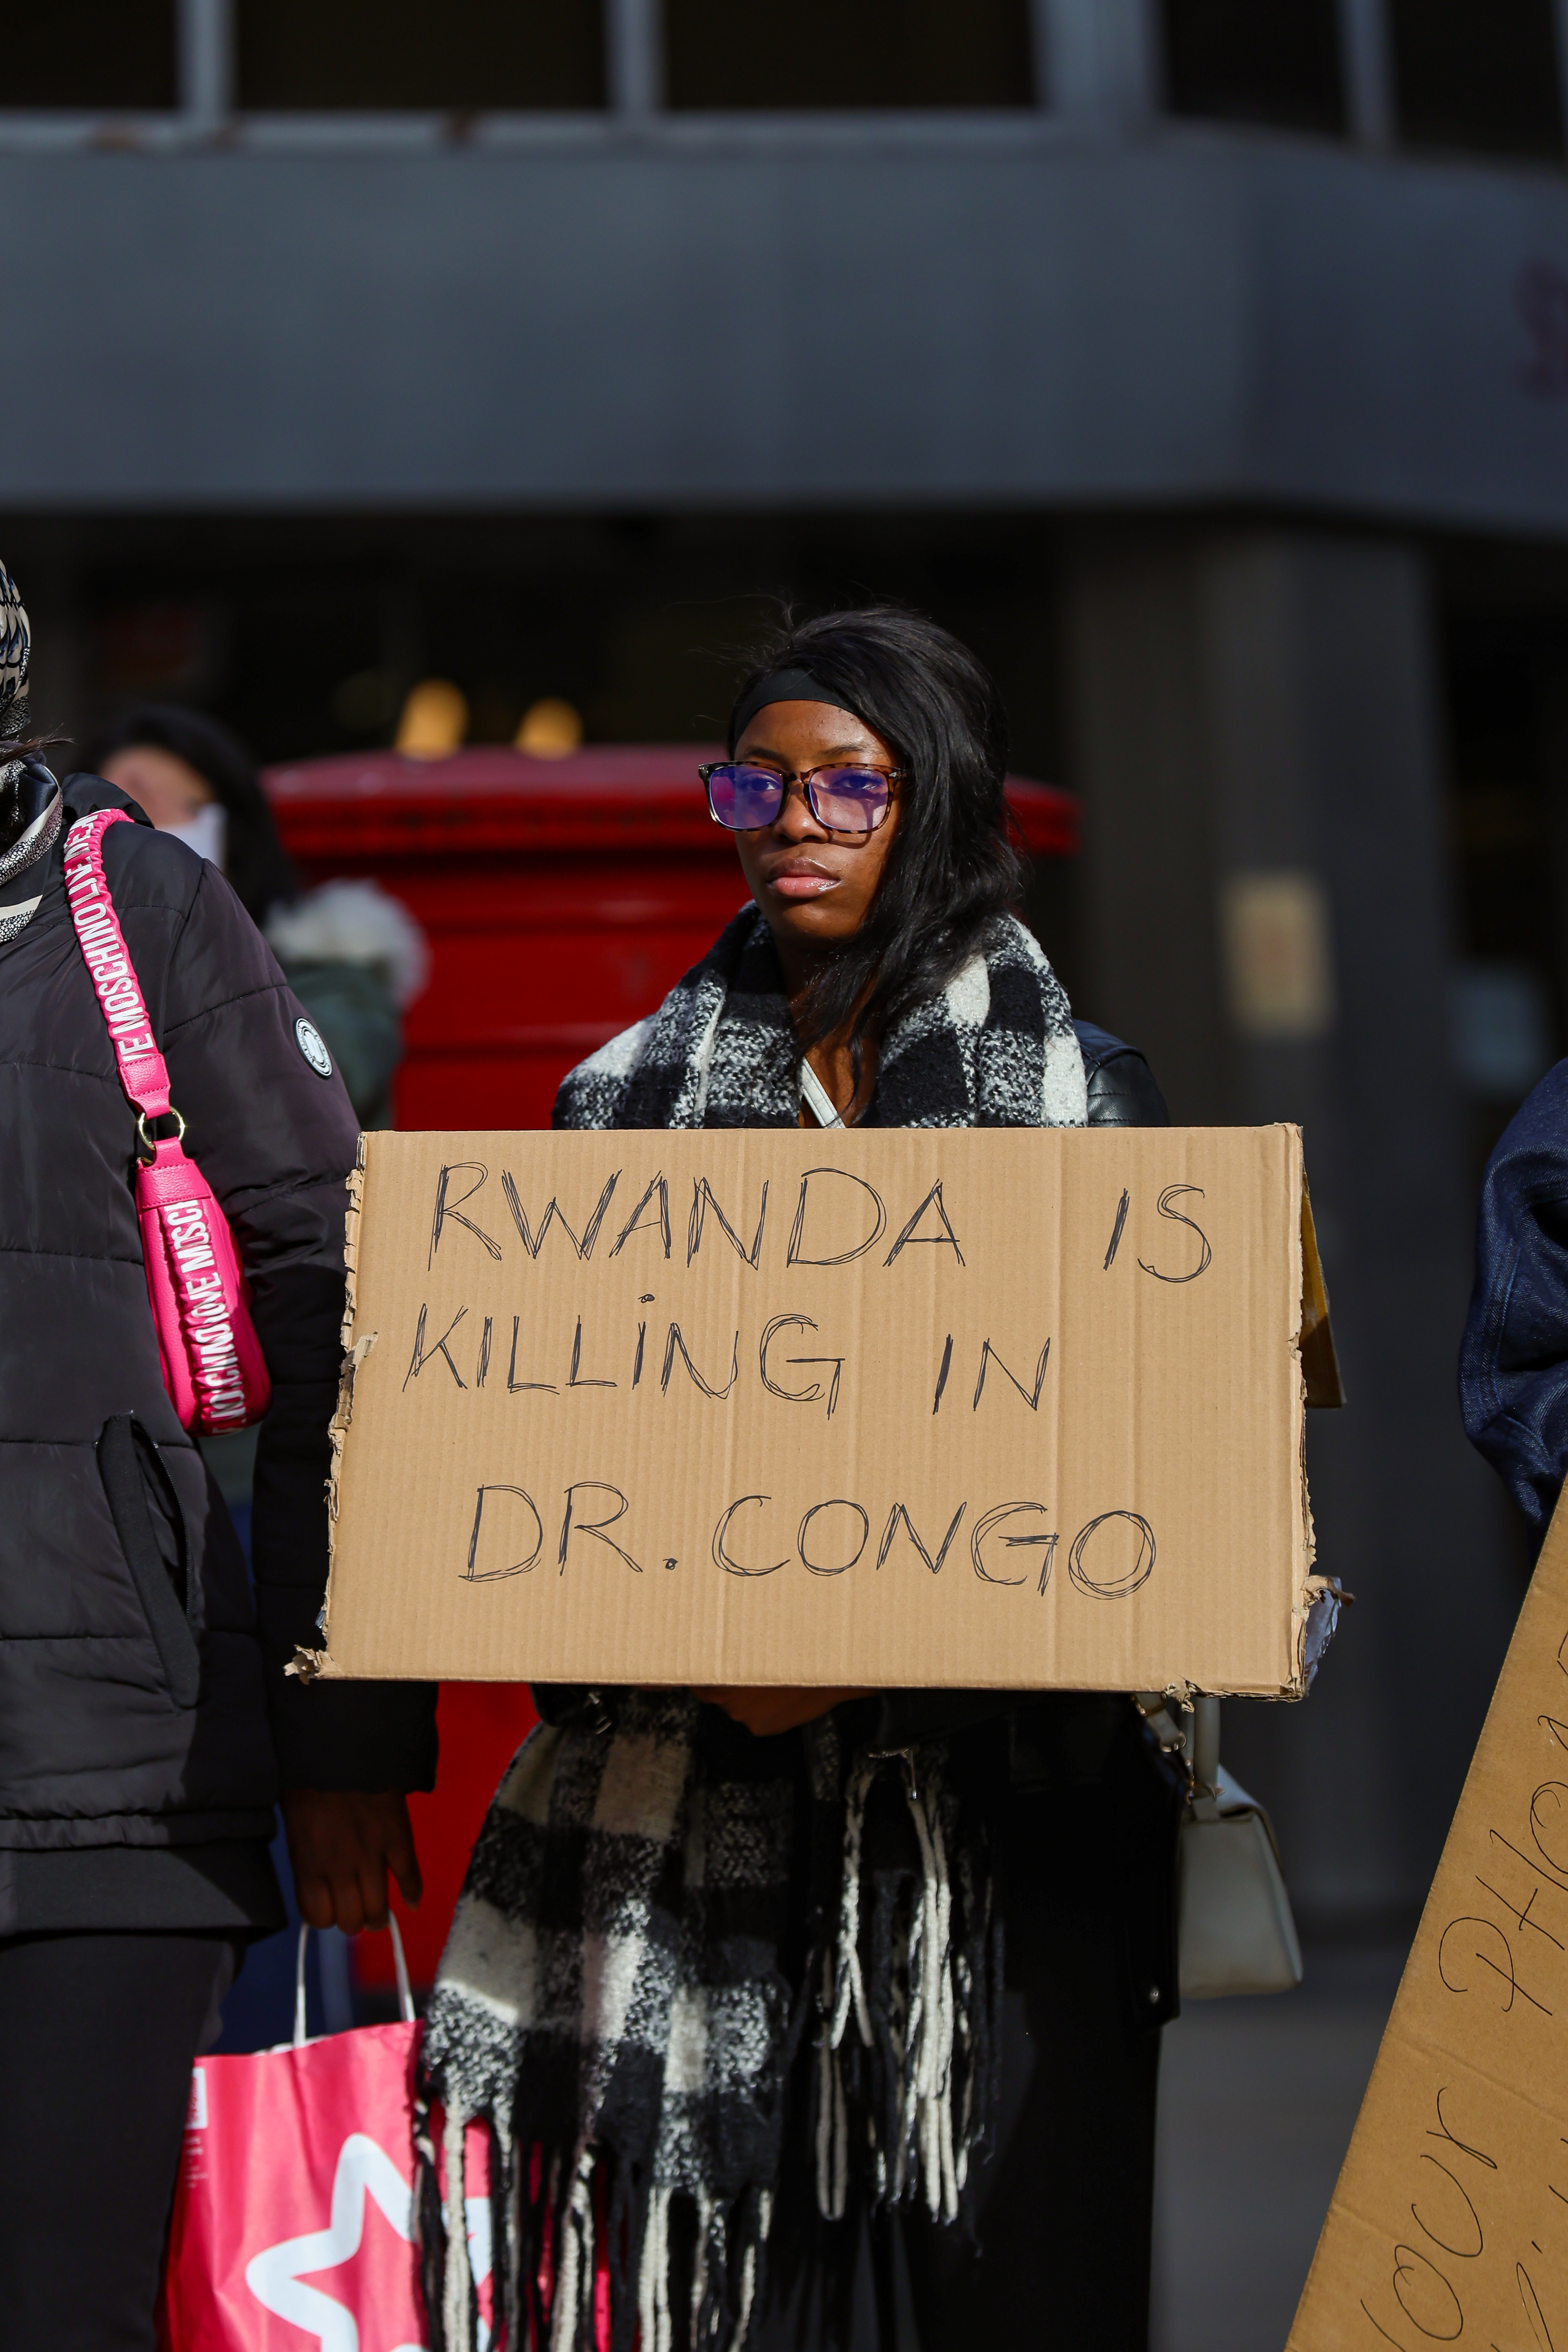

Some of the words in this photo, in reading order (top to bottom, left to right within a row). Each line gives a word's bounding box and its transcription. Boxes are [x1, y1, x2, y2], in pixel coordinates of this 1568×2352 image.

[74, 902, 145, 1035] MOSCHINO
[428, 1161, 966, 1271] RWANDA
[1103, 1184, 1212, 1283] IS
[933, 1333, 1050, 1415] IN
[712, 1495, 1156, 1600] CONGO
